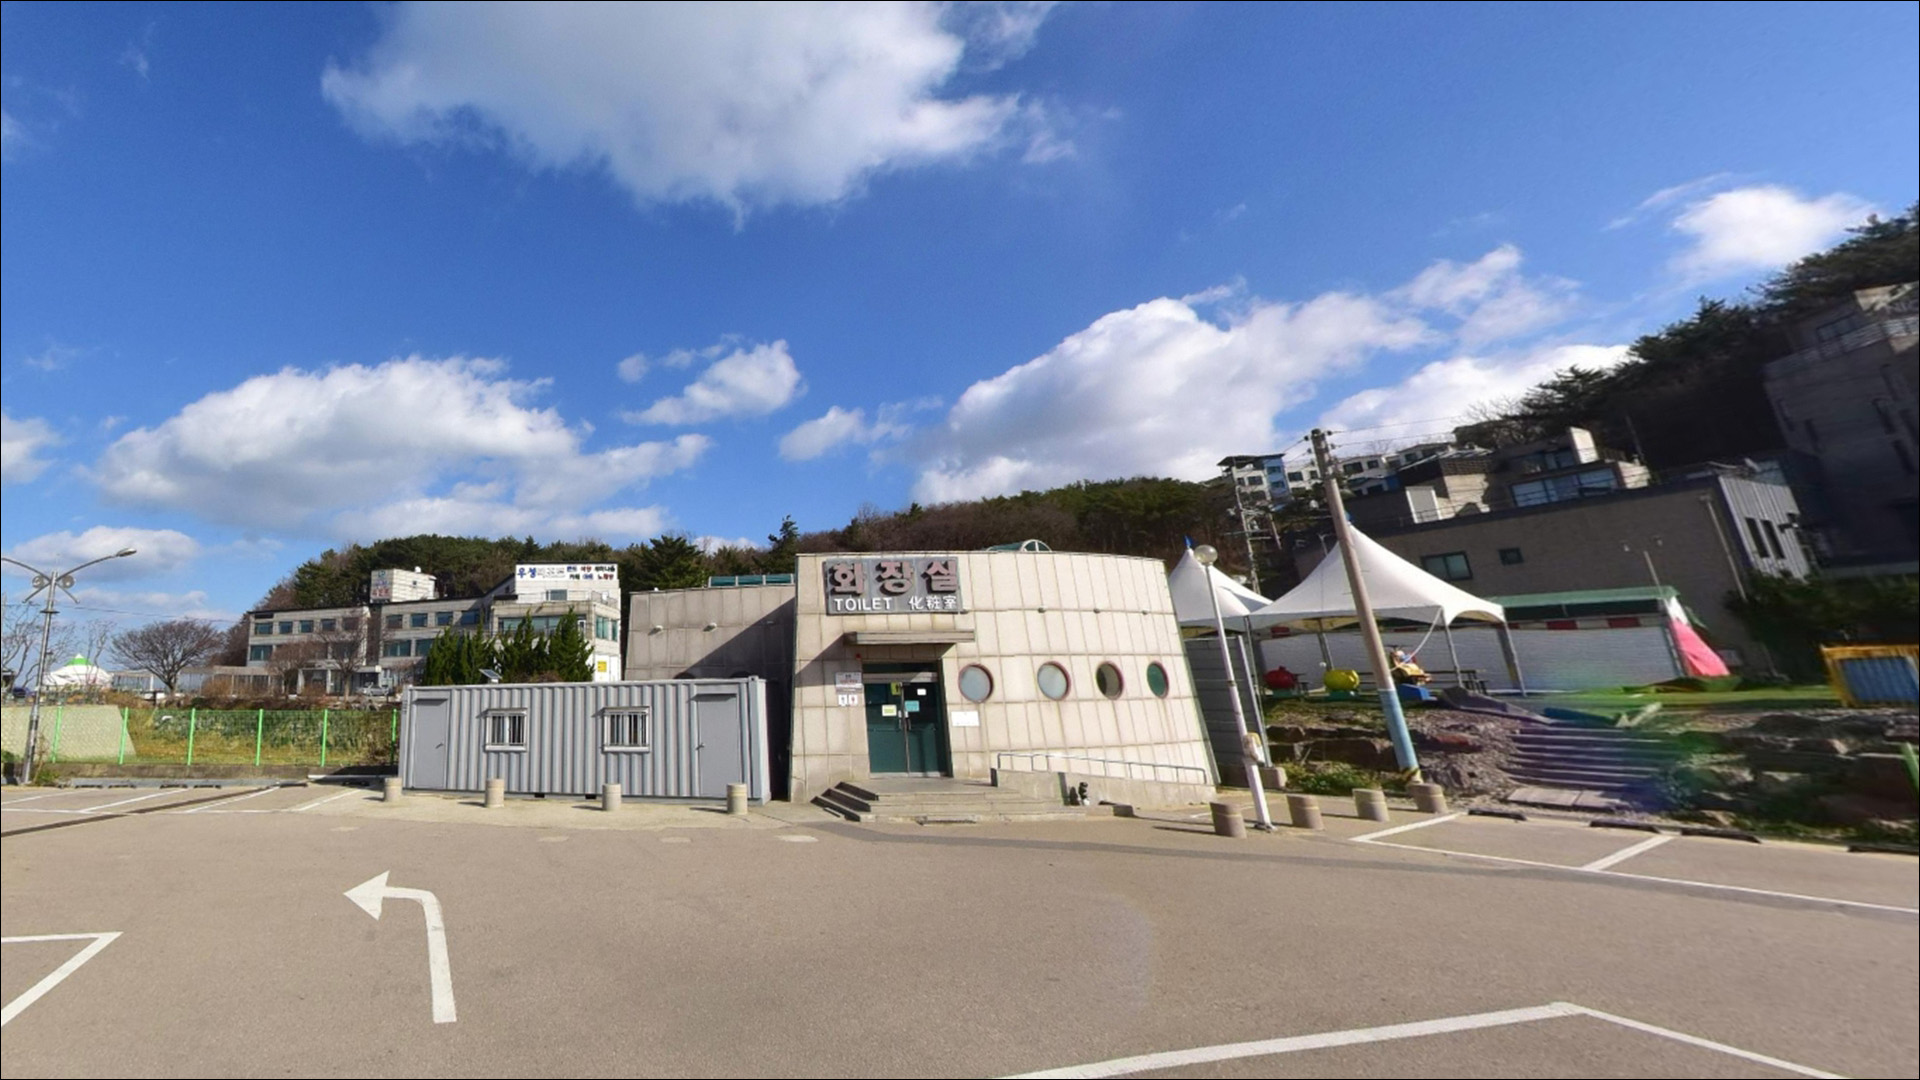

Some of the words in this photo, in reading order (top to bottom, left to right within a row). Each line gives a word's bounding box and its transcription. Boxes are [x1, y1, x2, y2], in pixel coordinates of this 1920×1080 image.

[830, 561, 957, 595] 화장실
[834, 597, 892, 611] TOILET
[908, 595, 957, 610] 化粧室
